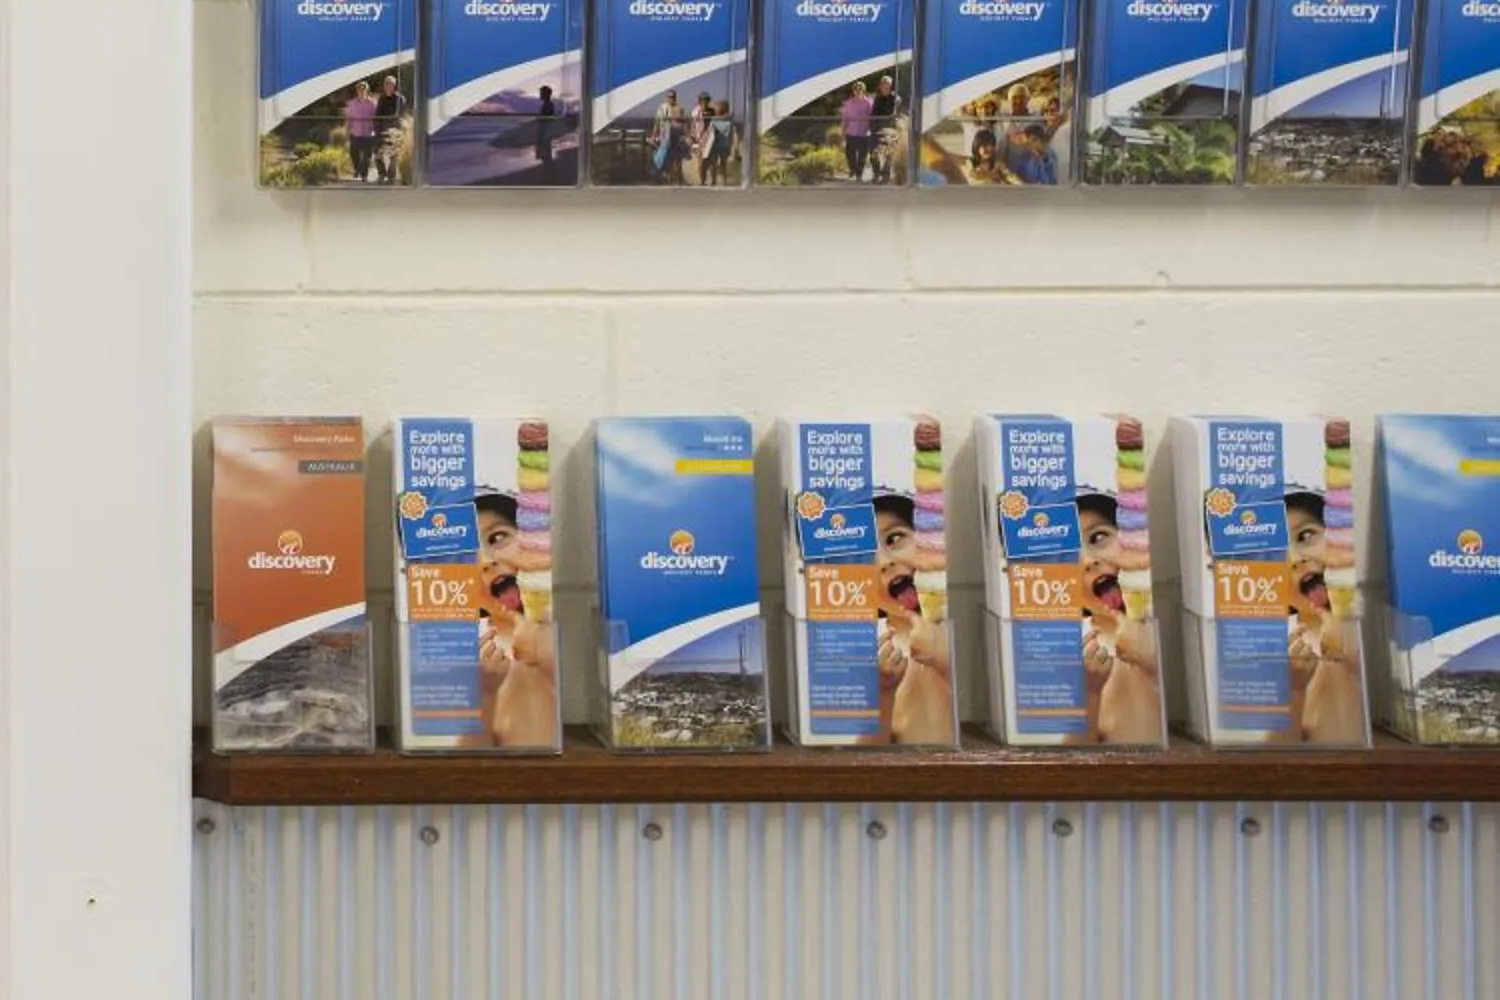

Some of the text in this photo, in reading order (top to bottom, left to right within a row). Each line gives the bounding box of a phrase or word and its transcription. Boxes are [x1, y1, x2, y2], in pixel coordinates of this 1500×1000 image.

[298, 0, 383, 22] discovery
[464, 0, 550, 22] discovery
[629, 0, 715, 21] discovery
[796, 0, 881, 22] discovery
[959, 0, 1045, 22] discovery
[1127, 0, 1213, 22] discovery
[1292, 0, 1380, 23] discovery
[410, 430, 465, 445] Explore
[807, 430, 863, 446] Explore
[1009, 429, 1065, 445] Explore
[1217, 428, 1275, 443] Explore
[441, 445, 465, 454] with
[839, 446, 863, 454] with
[1041, 445, 1065, 454] with
[1250, 443, 1275, 452] with
[411, 456, 466, 474] bigger
[808, 457, 864, 475] bigger
[1011, 456, 1066, 474] bigger
[1218, 453, 1275, 471] bigger
[411, 475, 466, 491] savings
[809, 476, 865, 491] savings
[1011, 474, 1067, 490] savings
[1219, 473, 1276, 488] savings
[247, 552, 336, 575] discovery
[640, 552, 728, 575] discovery
[1217, 564, 1249, 575] Save
[412, 567, 441, 578] Save
[808, 567, 839, 579] Save
[1012, 566, 1043, 578] Save
